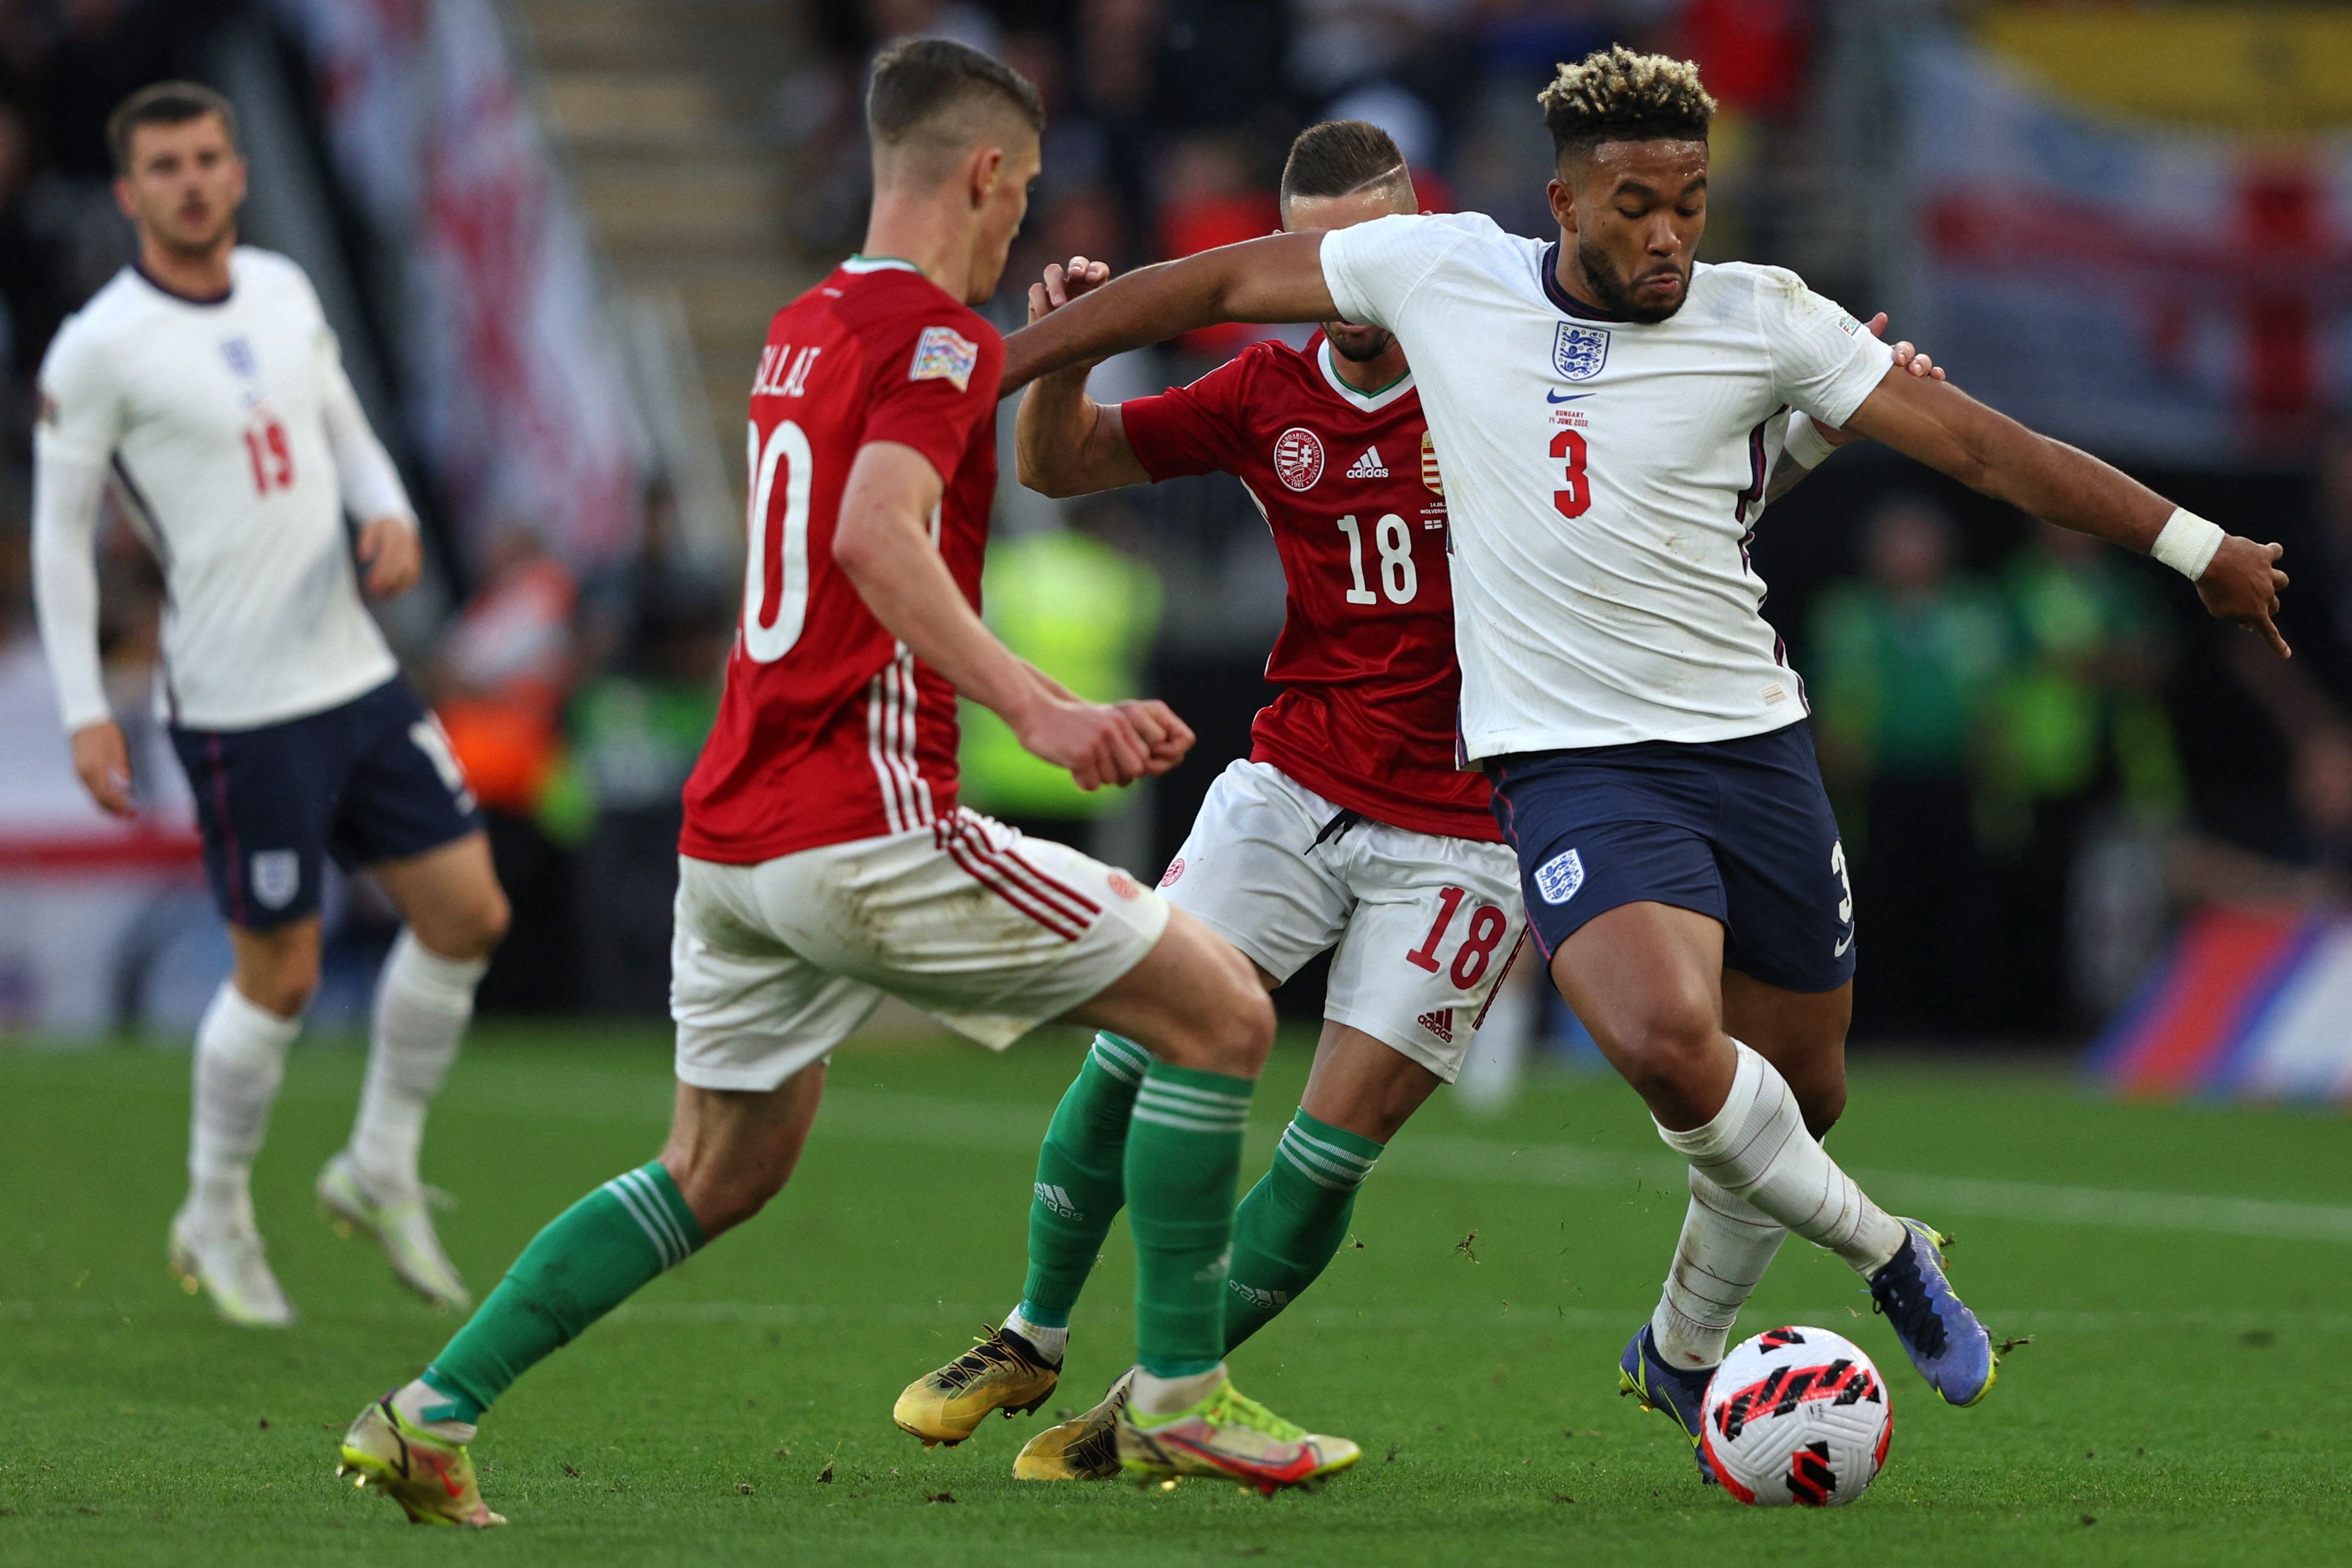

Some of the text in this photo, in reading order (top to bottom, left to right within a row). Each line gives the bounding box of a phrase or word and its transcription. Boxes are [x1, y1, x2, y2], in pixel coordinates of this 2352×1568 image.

[1555, 409, 1584, 418] HUNGARY
[1556, 418, 1572, 426] JUNE
[243, 424, 293, 495] 19
[1277, 449, 1285, 479] MAGYAR
[1346, 467, 1389, 479] adidas
[1549, 429, 1591, 519] 3
[742, 419, 813, 663] 0
[1337, 513, 1417, 604] 18
[1831, 840, 1852, 923] 3
[1406, 887, 1507, 990] 18
[1417, 1015, 1452, 1043] adidas
